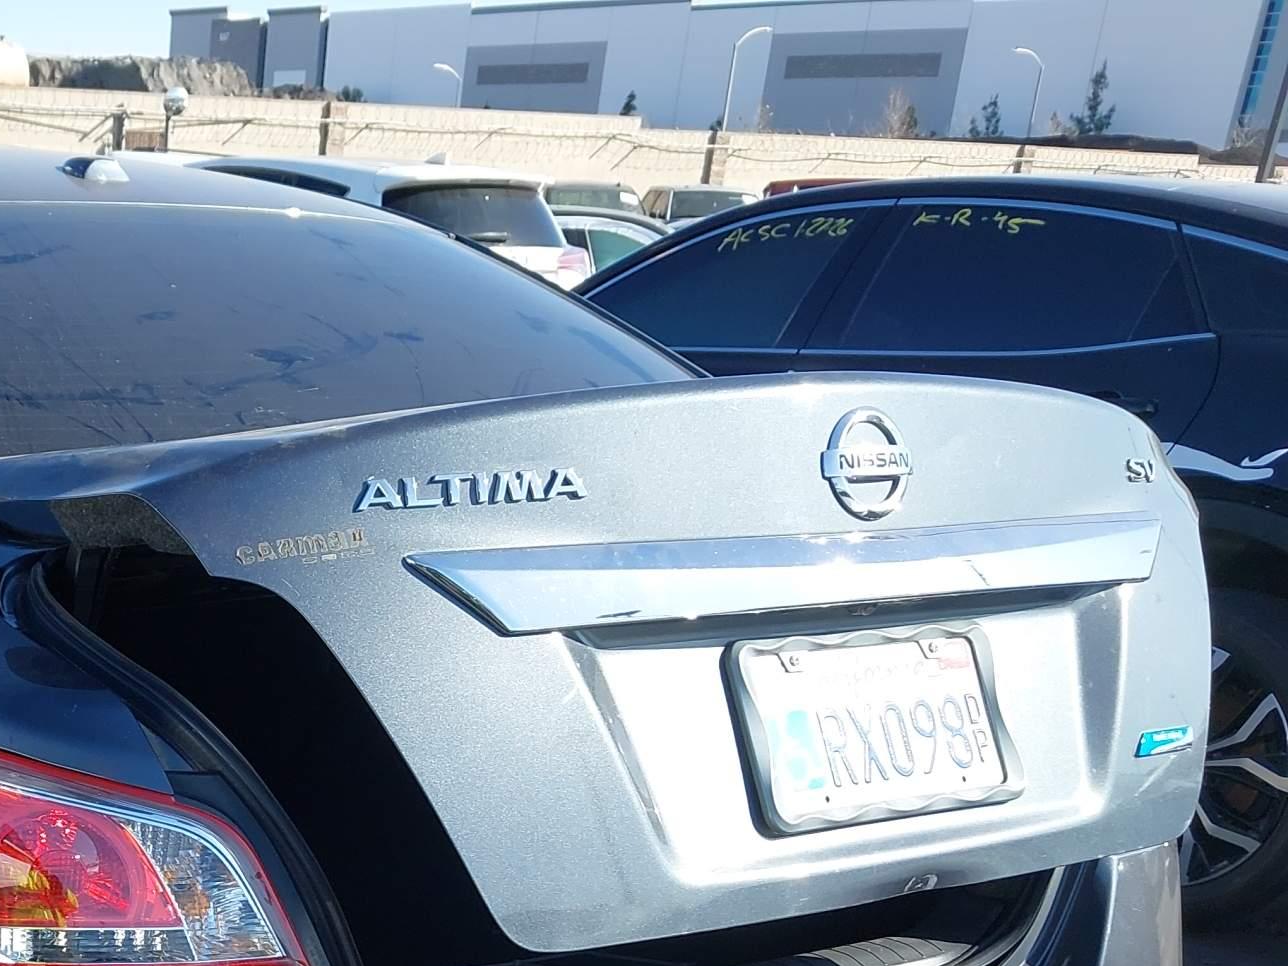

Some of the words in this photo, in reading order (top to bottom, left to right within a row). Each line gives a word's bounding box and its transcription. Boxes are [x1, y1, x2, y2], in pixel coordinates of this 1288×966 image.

[839, 452, 909, 470] NISSAN
[1127, 459, 1155, 483] SV
[353, 466, 588, 513] ALTIMA
[816, 695, 974, 788] RX098
